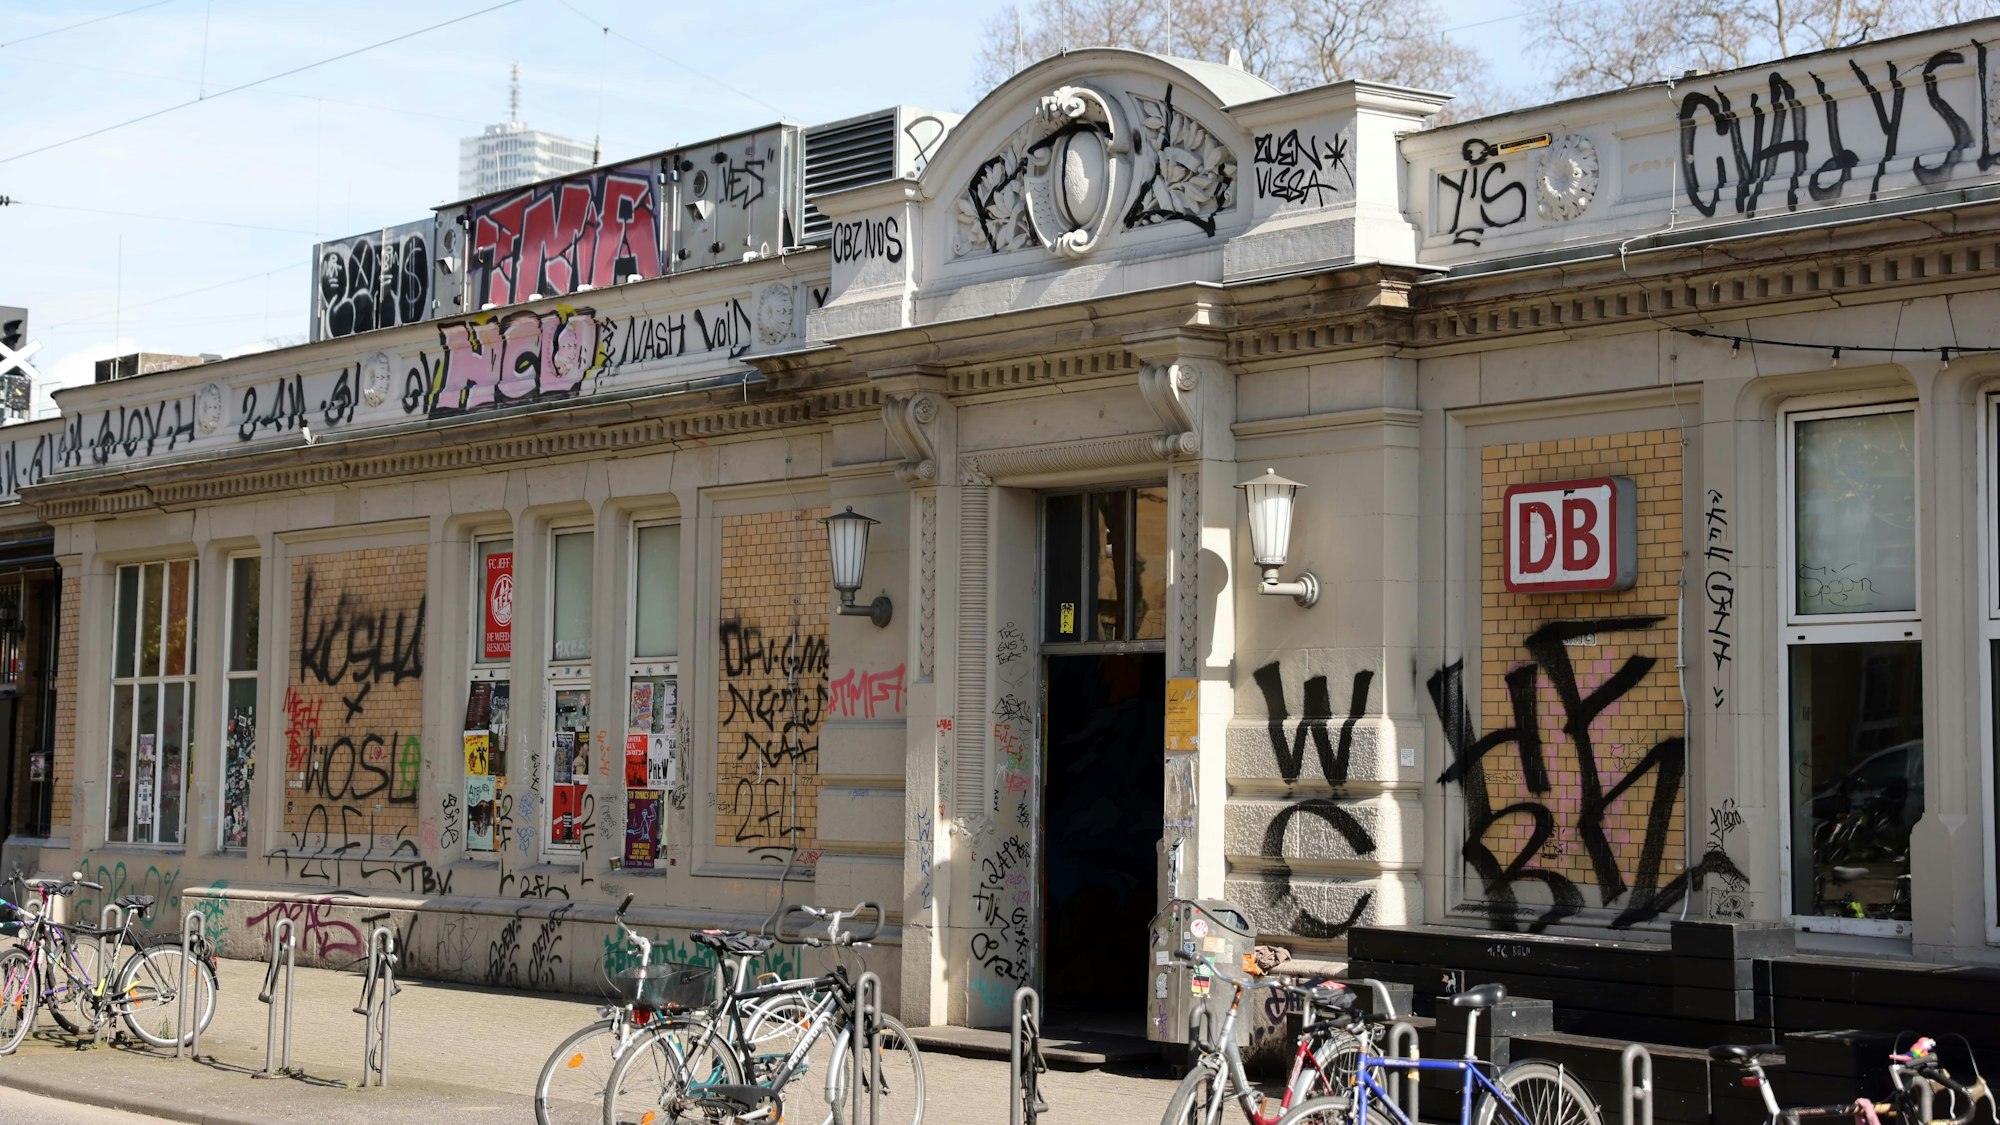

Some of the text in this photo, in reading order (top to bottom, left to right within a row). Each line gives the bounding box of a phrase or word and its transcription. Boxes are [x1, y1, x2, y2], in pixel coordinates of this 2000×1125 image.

[1518, 498, 1601, 574] DB
[1253, 660, 1374, 785] W
[1262, 799, 1377, 939] C
